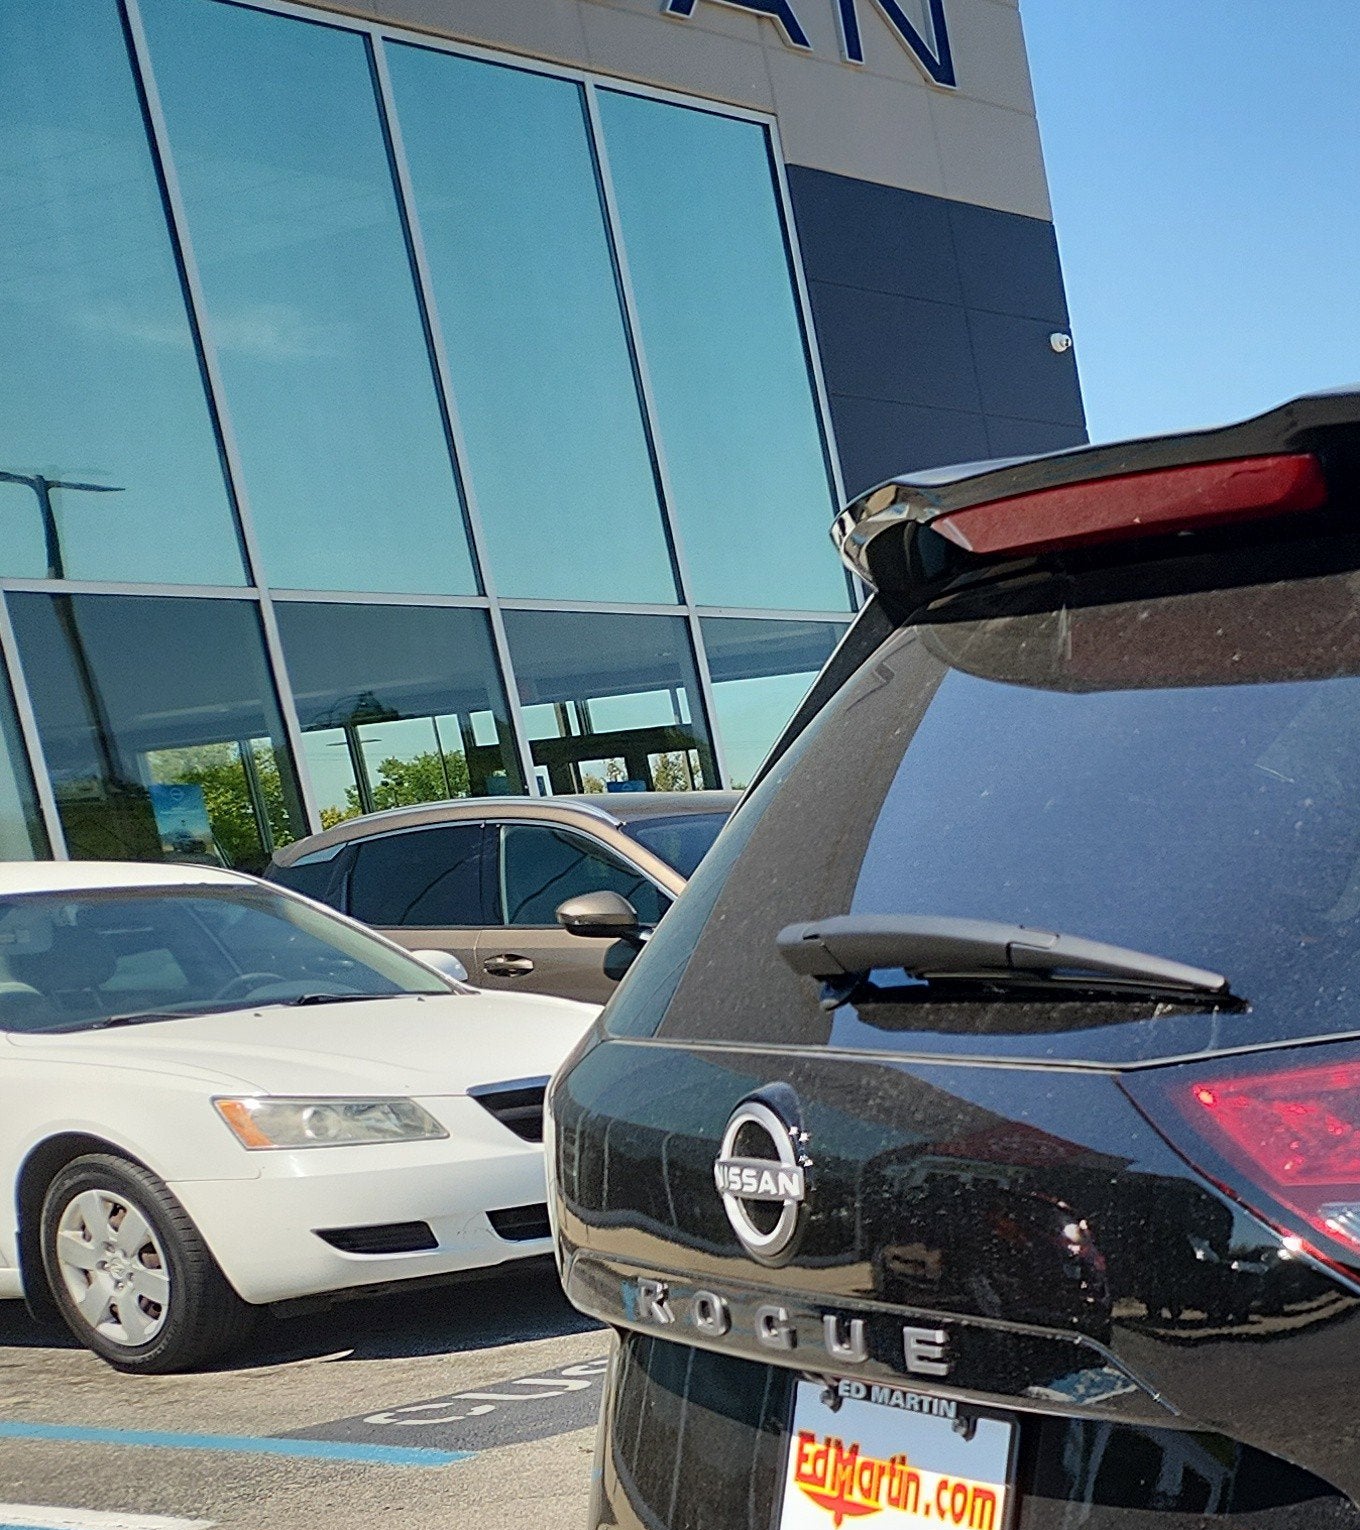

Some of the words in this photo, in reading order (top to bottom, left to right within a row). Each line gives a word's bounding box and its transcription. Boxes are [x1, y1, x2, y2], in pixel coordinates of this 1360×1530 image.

[715, 1162, 801, 1197] NISSAN
[637, 1276, 949, 1376] ROGUE
[838, 1379, 867, 1399] ED
[871, 1384, 957, 1419] MARTIN
